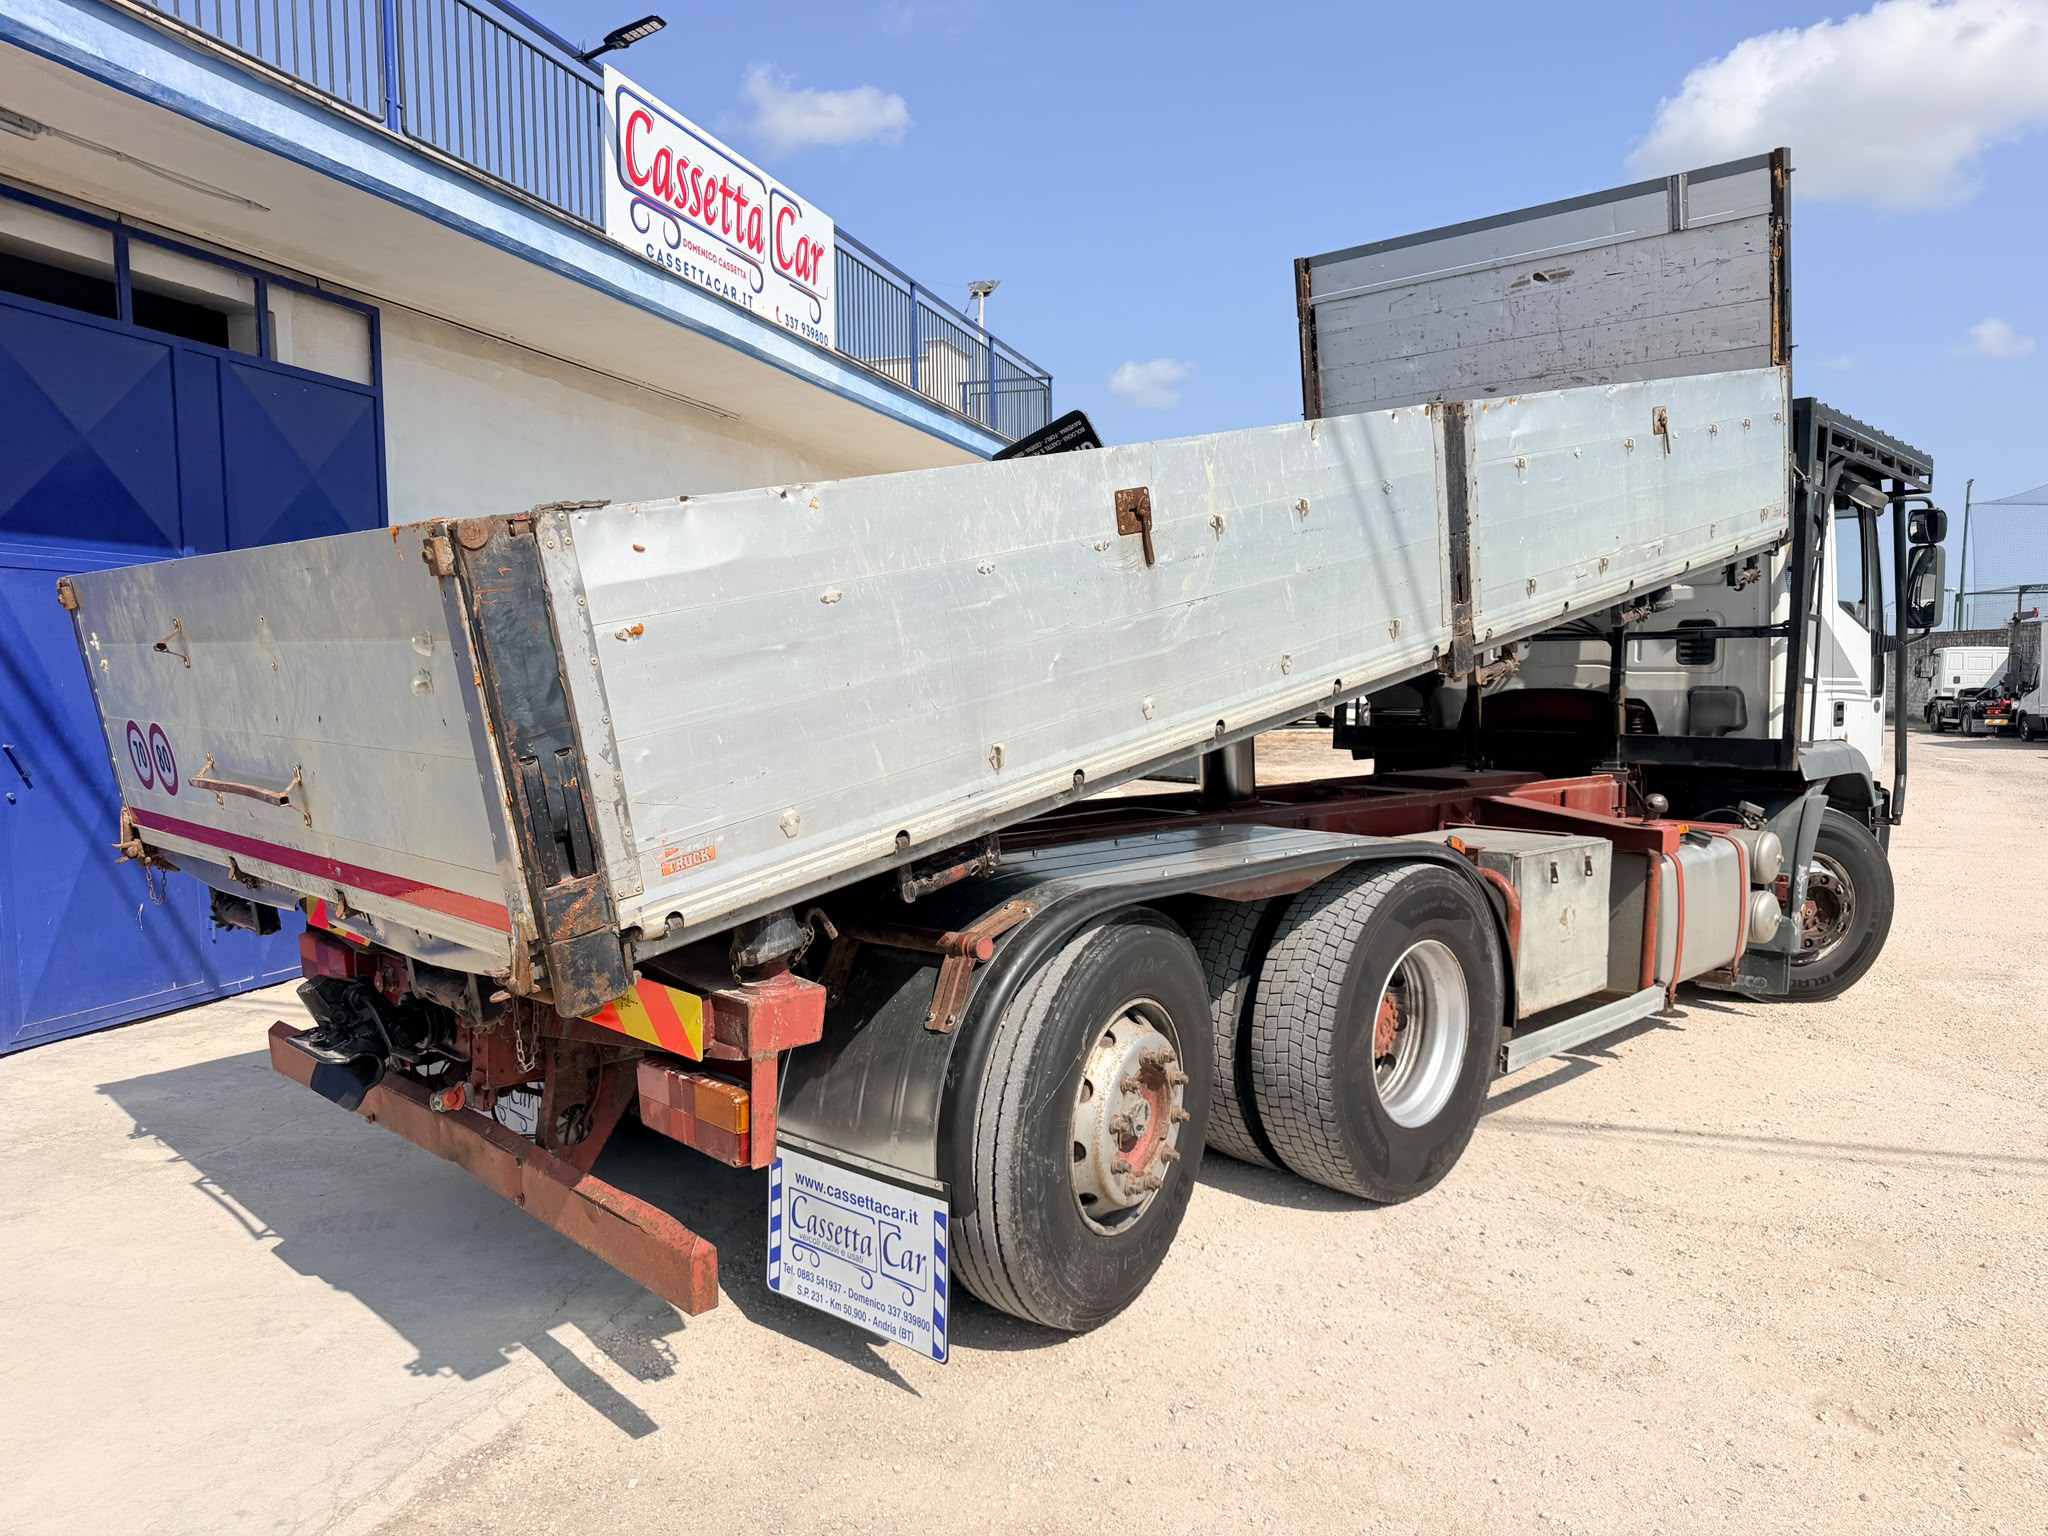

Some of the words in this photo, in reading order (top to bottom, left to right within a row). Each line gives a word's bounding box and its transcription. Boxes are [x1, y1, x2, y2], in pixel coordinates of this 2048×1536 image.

[626, 109, 765, 255] Cassetta
[776, 206, 826, 286] Car
[646, 243, 754, 309] CASSETTACAR.IT
[683, 238, 718, 264] DOMENICO
[718, 257, 748, 280] CASSETTA
[785, 314, 799, 331] 337
[801, 322, 829, 347] 939800
[1060, 419, 1083, 436] RAVENNA
[1063, 426, 1086, 442] BOLOGNA
[132, 740, 148, 769] 70
[155, 744, 172, 774] 80
[666, 846, 712, 873] TRUCK
[795, 1172, 919, 1226] www.cassettacar.it
[791, 1195, 873, 1257] Cassetta
[883, 1232, 927, 1275] Car
[799, 1232, 820, 1245] veicoli
[821, 1242, 840, 1254] nuovi
[846, 1252, 864, 1264] usati
[783, 1262, 796, 1276] Tel.
[796, 1267, 815, 1283] 0883
[816, 1274, 842, 1293] 541937
[848, 1287, 886, 1313] Domenico
[887, 1304, 931, 1332] 337.939800
[796, 1284, 810, 1299] S.P.
[810, 1289, 824, 1304] 231
[829, 1297, 842, 1312] Km
[872, 1317, 897, 1336] Andria
[898, 1326, 915, 1344] (BT)
